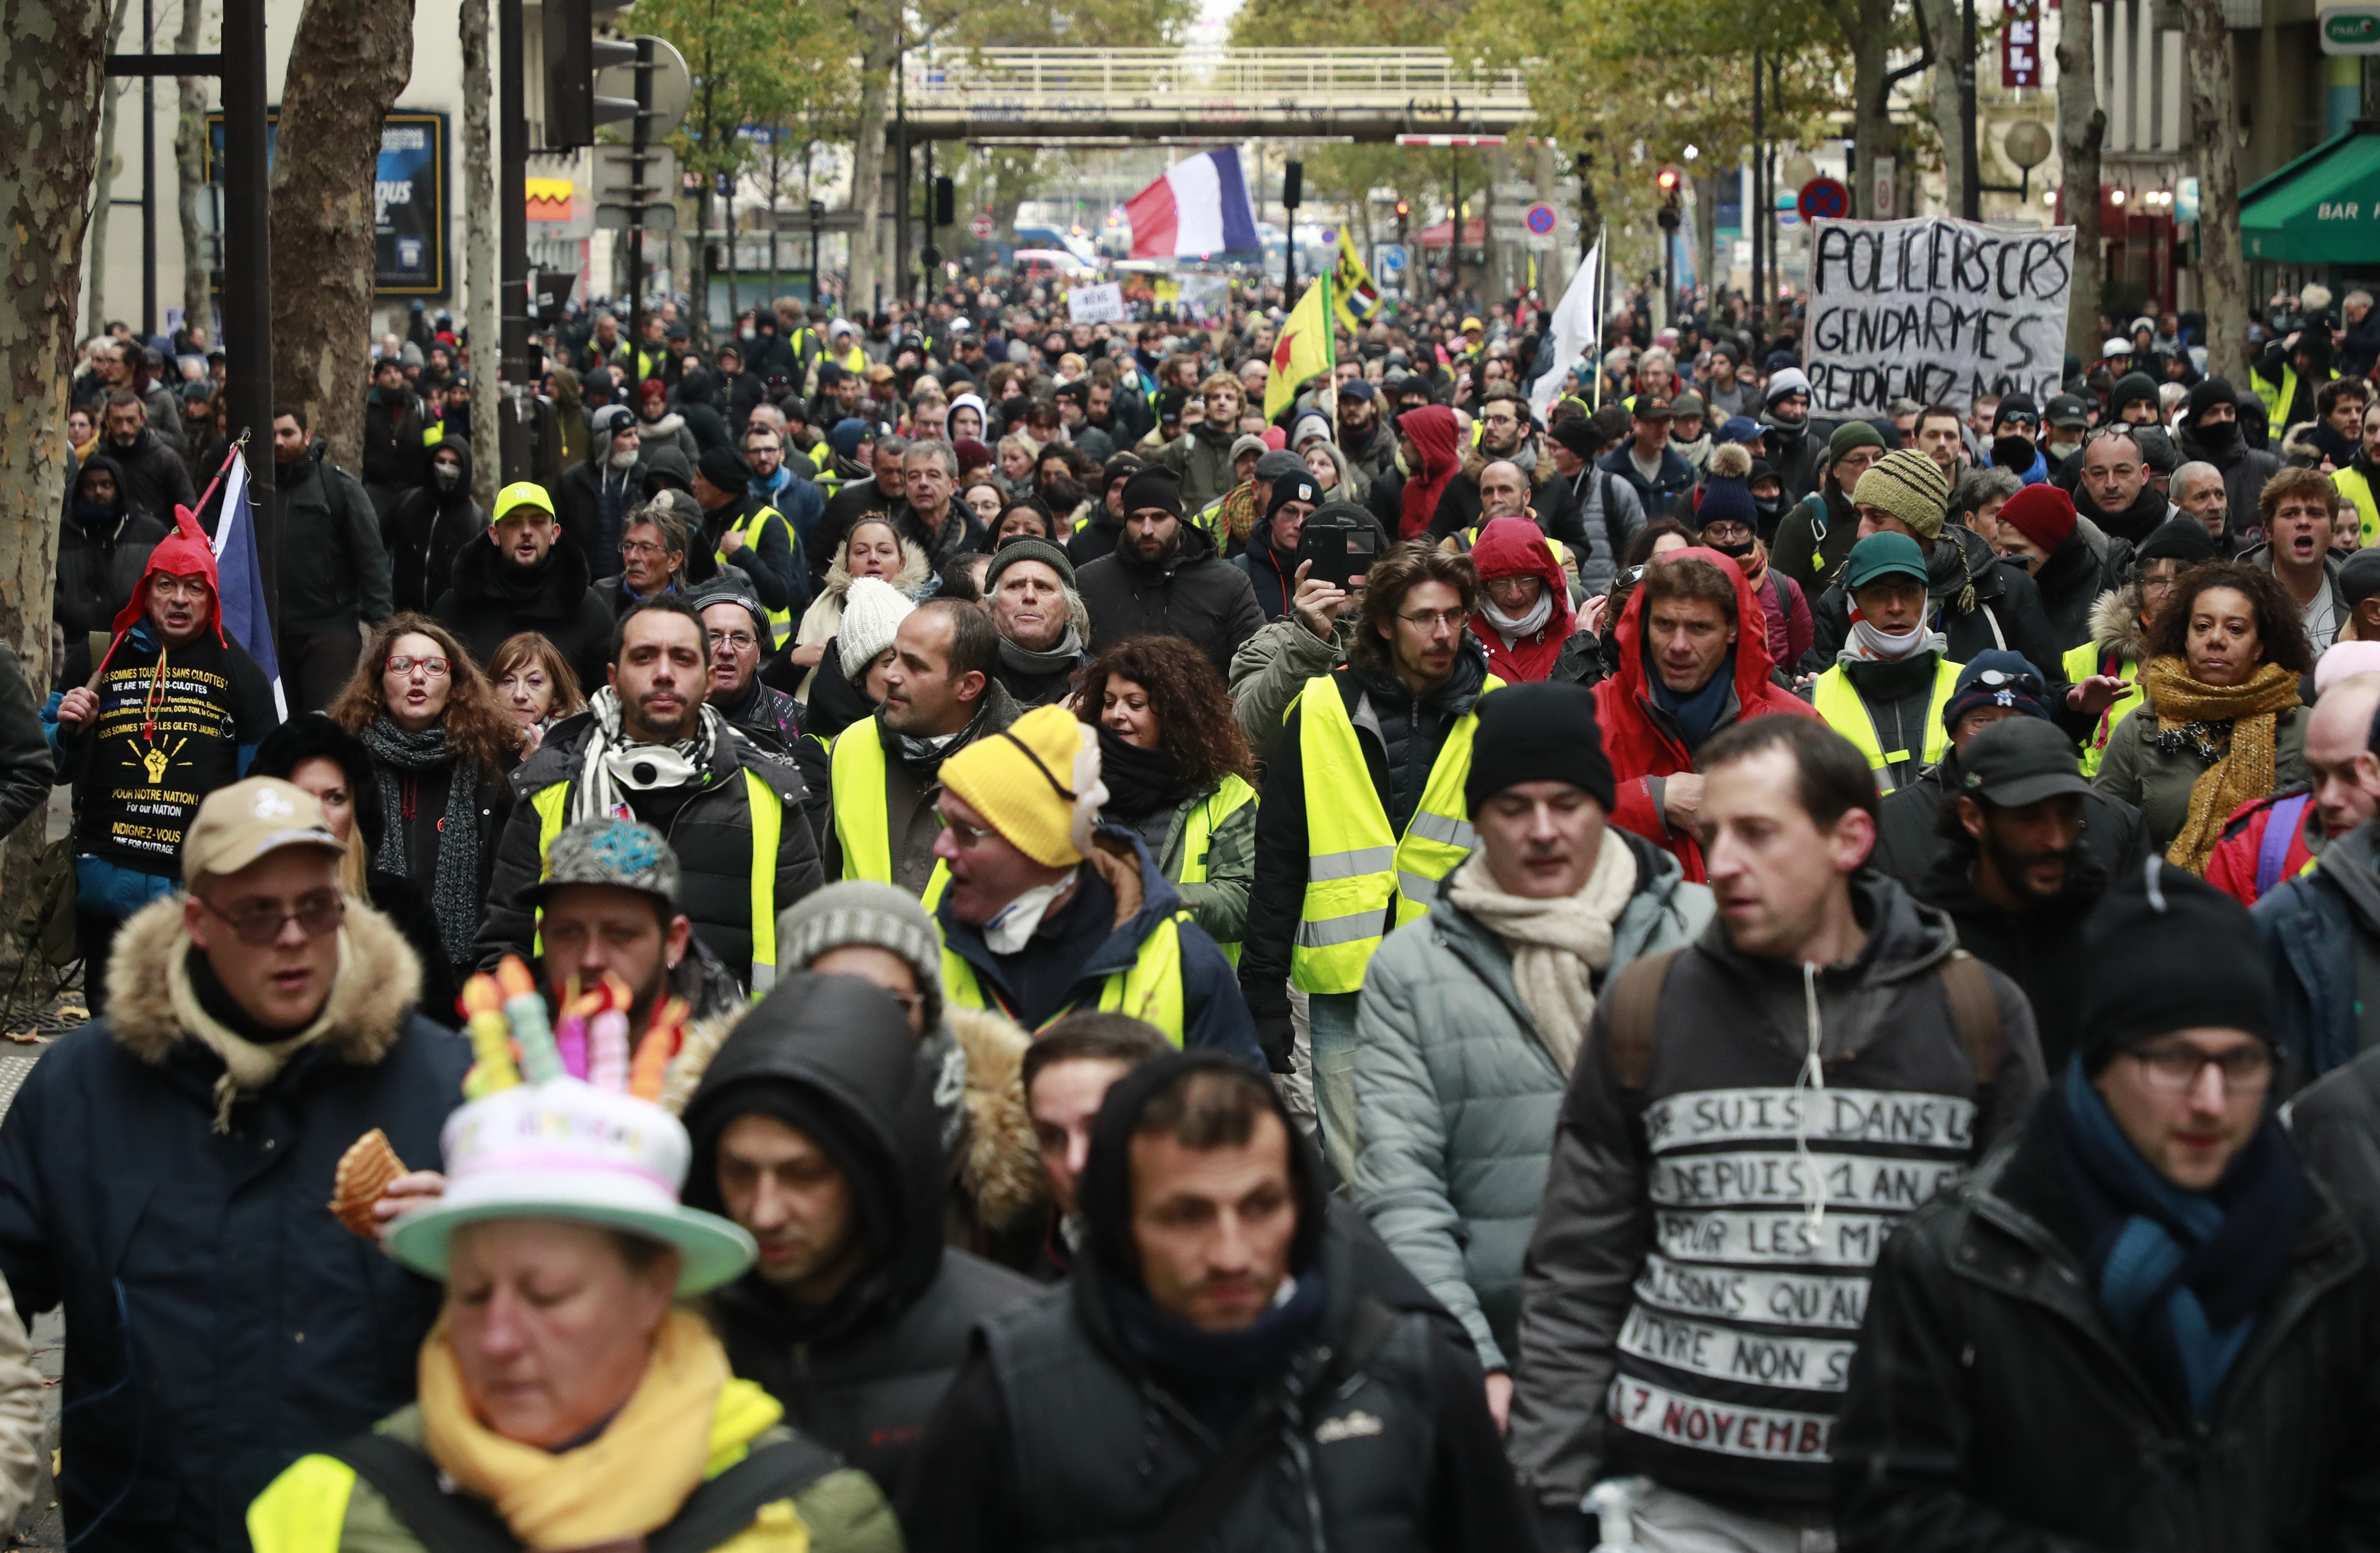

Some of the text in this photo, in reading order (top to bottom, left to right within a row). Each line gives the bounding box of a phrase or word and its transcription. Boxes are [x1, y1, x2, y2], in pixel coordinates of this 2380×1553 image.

[2317, 202, 2359, 220] BAR
[1996, 239, 2071, 301] CRS
[1815, 296, 2042, 370] GENDARMES
[110, 668, 137, 681] SOMMES
[139, 667, 156, 678] TOUS
[172, 667, 190, 678] SANS
[112, 680, 208, 694] WE ARE THE AS-CULOTTES
[168, 696, 206, 708] Fonctionnaires,
[174, 705, 201, 716] DOM-TOM,
[206, 711, 220, 720] Corse
[112, 723, 138, 735] SOMMES
[139, 722, 158, 731] TS
[159, 722, 171, 730] LES
[173, 722, 197, 732] GILETS
[112, 788, 133, 800] POUR
[134, 789, 162, 801] NOTRE
[126, 801, 182, 817] For our NATION
[111, 822, 181, 843] INDIGNEZ-VOUS
[128, 839, 142, 849] FOR
[142, 841, 175, 855] OUTRAGE
[1693, 1095, 1802, 1134] SUIS
[1827, 1095, 1935, 1140] DANS
[1671, 1160, 1805, 1201] DEPUIS
[1829, 1162, 1859, 1197] 1
[1872, 1168, 1919, 1206] AN
[1749, 1219, 1813, 1256] LES
[1731, 1337, 1805, 1380] NON
[1613, 1382, 1650, 1427] 17
